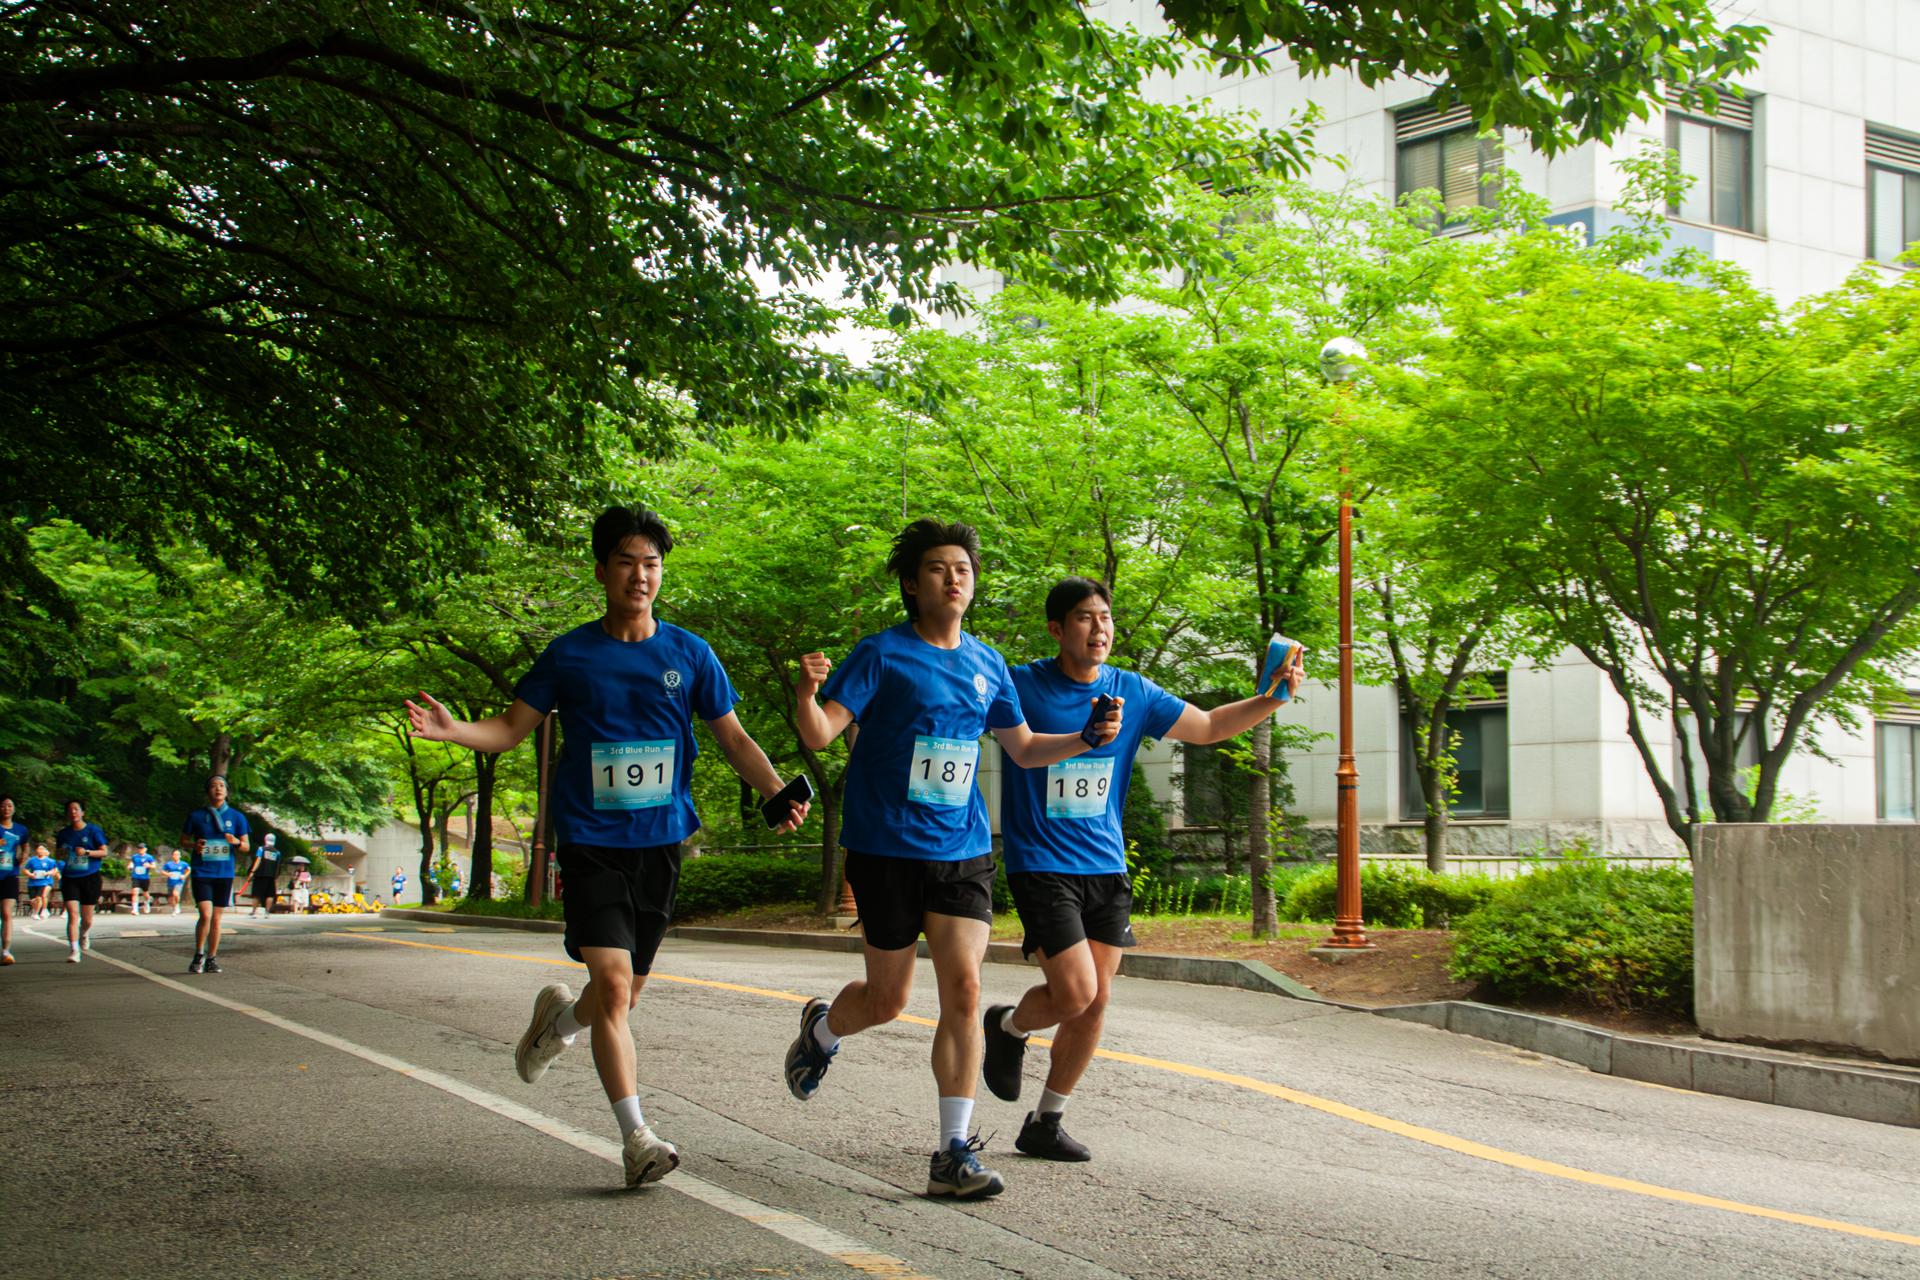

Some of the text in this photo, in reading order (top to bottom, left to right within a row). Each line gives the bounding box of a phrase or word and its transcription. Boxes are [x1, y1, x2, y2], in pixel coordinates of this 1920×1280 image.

[609, 745, 661, 755] 3rd Blue Run
[933, 741, 945, 750] 3rd
[603, 762, 664, 788] 191
[921, 758, 972, 785] 187
[1055, 777, 1107, 798] 189
